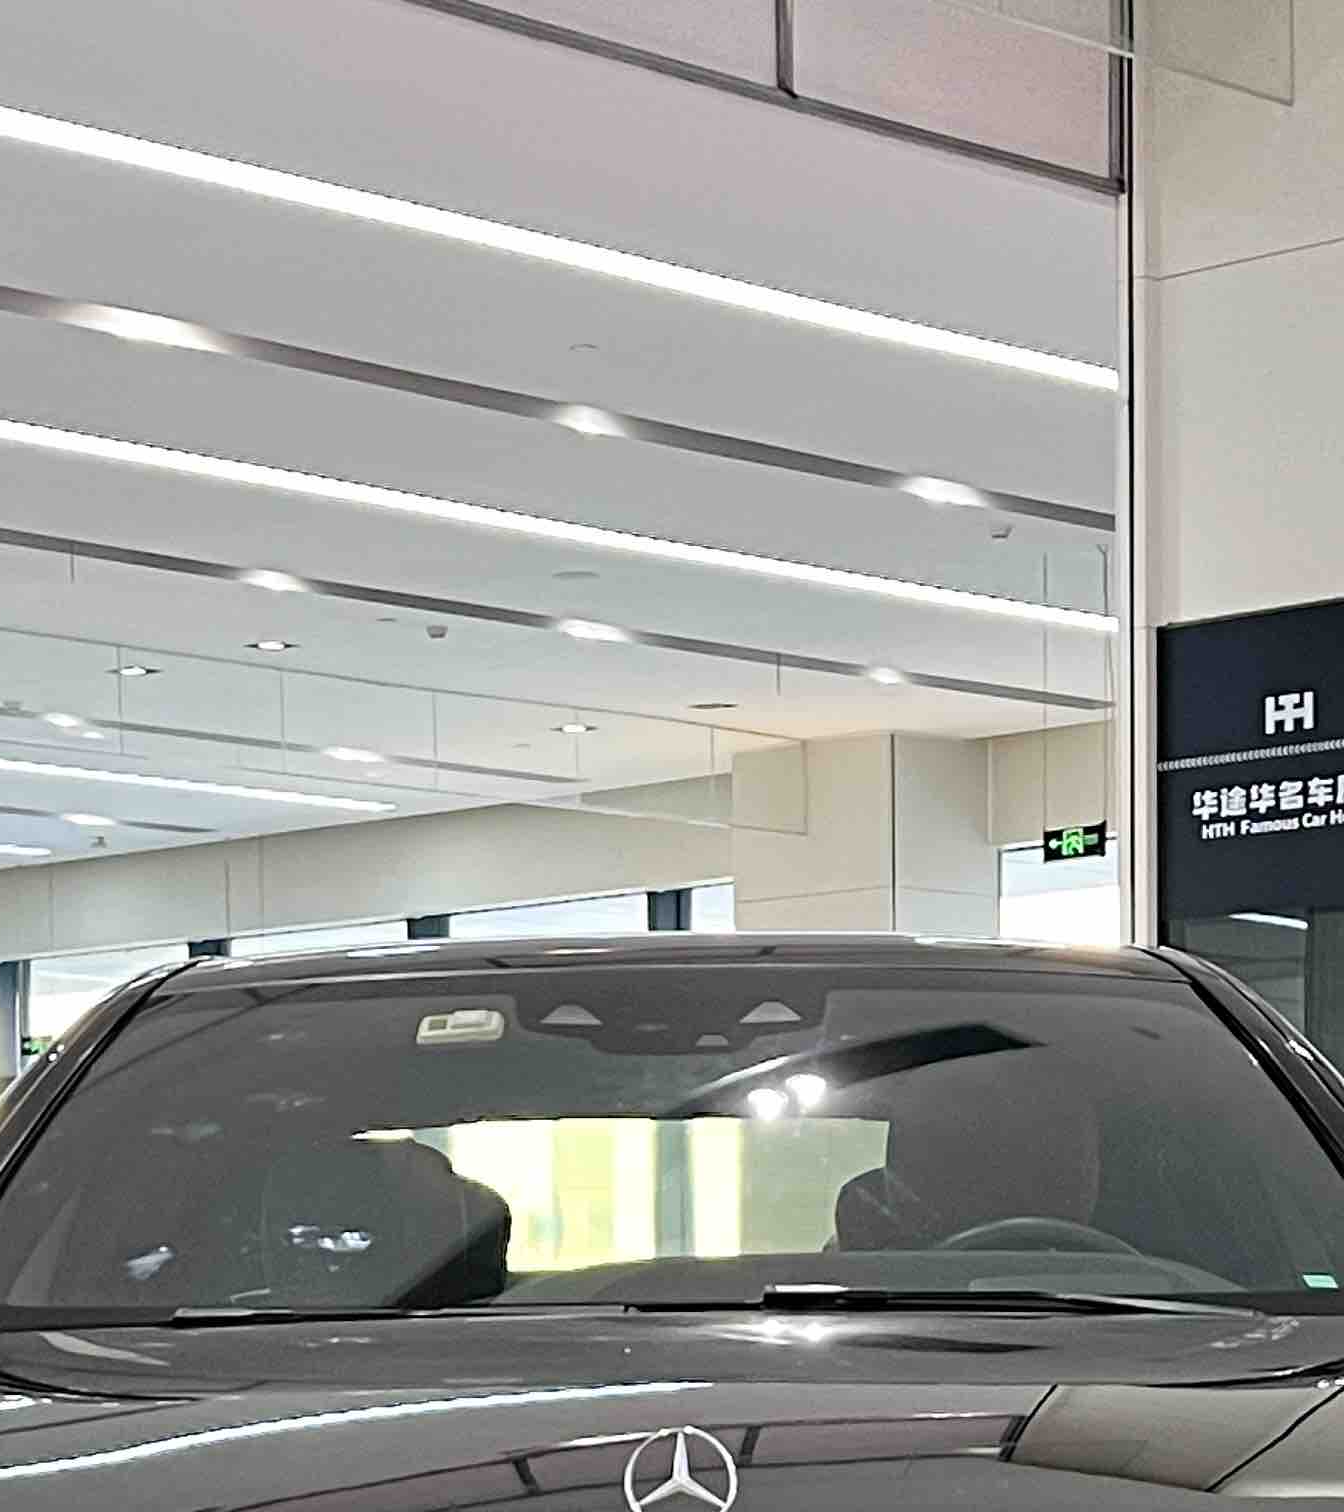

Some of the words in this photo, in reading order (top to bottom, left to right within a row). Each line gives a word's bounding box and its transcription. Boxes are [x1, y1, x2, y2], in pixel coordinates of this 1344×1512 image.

[1202, 822, 1235, 839] HTH
[1240, 817, 1299, 834] Famous
[1302, 813, 1327, 828] Car
